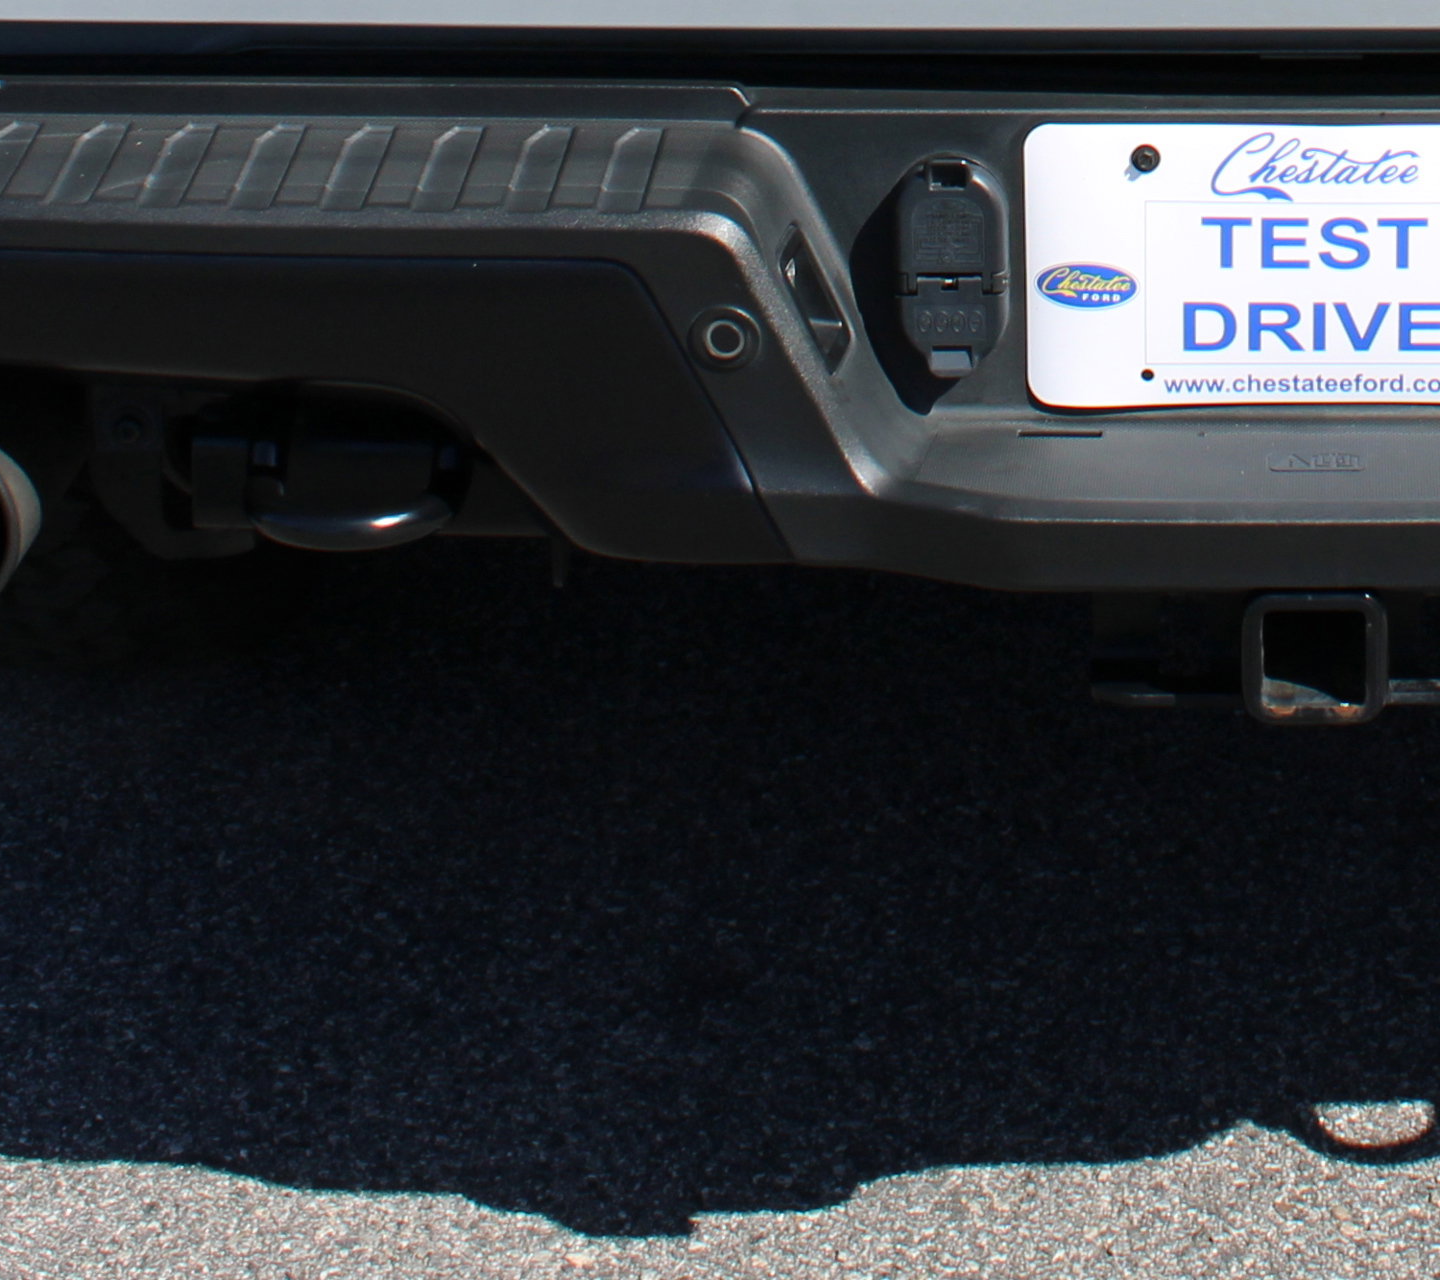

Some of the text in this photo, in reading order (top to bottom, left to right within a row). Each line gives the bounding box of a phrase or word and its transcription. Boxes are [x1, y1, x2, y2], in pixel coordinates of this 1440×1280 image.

[1210, 131, 1421, 203] Chestatee
[1201, 217, 1430, 270] TEST
[1041, 267, 1132, 298] Chestatee
[1081, 292, 1122, 302] FORD
